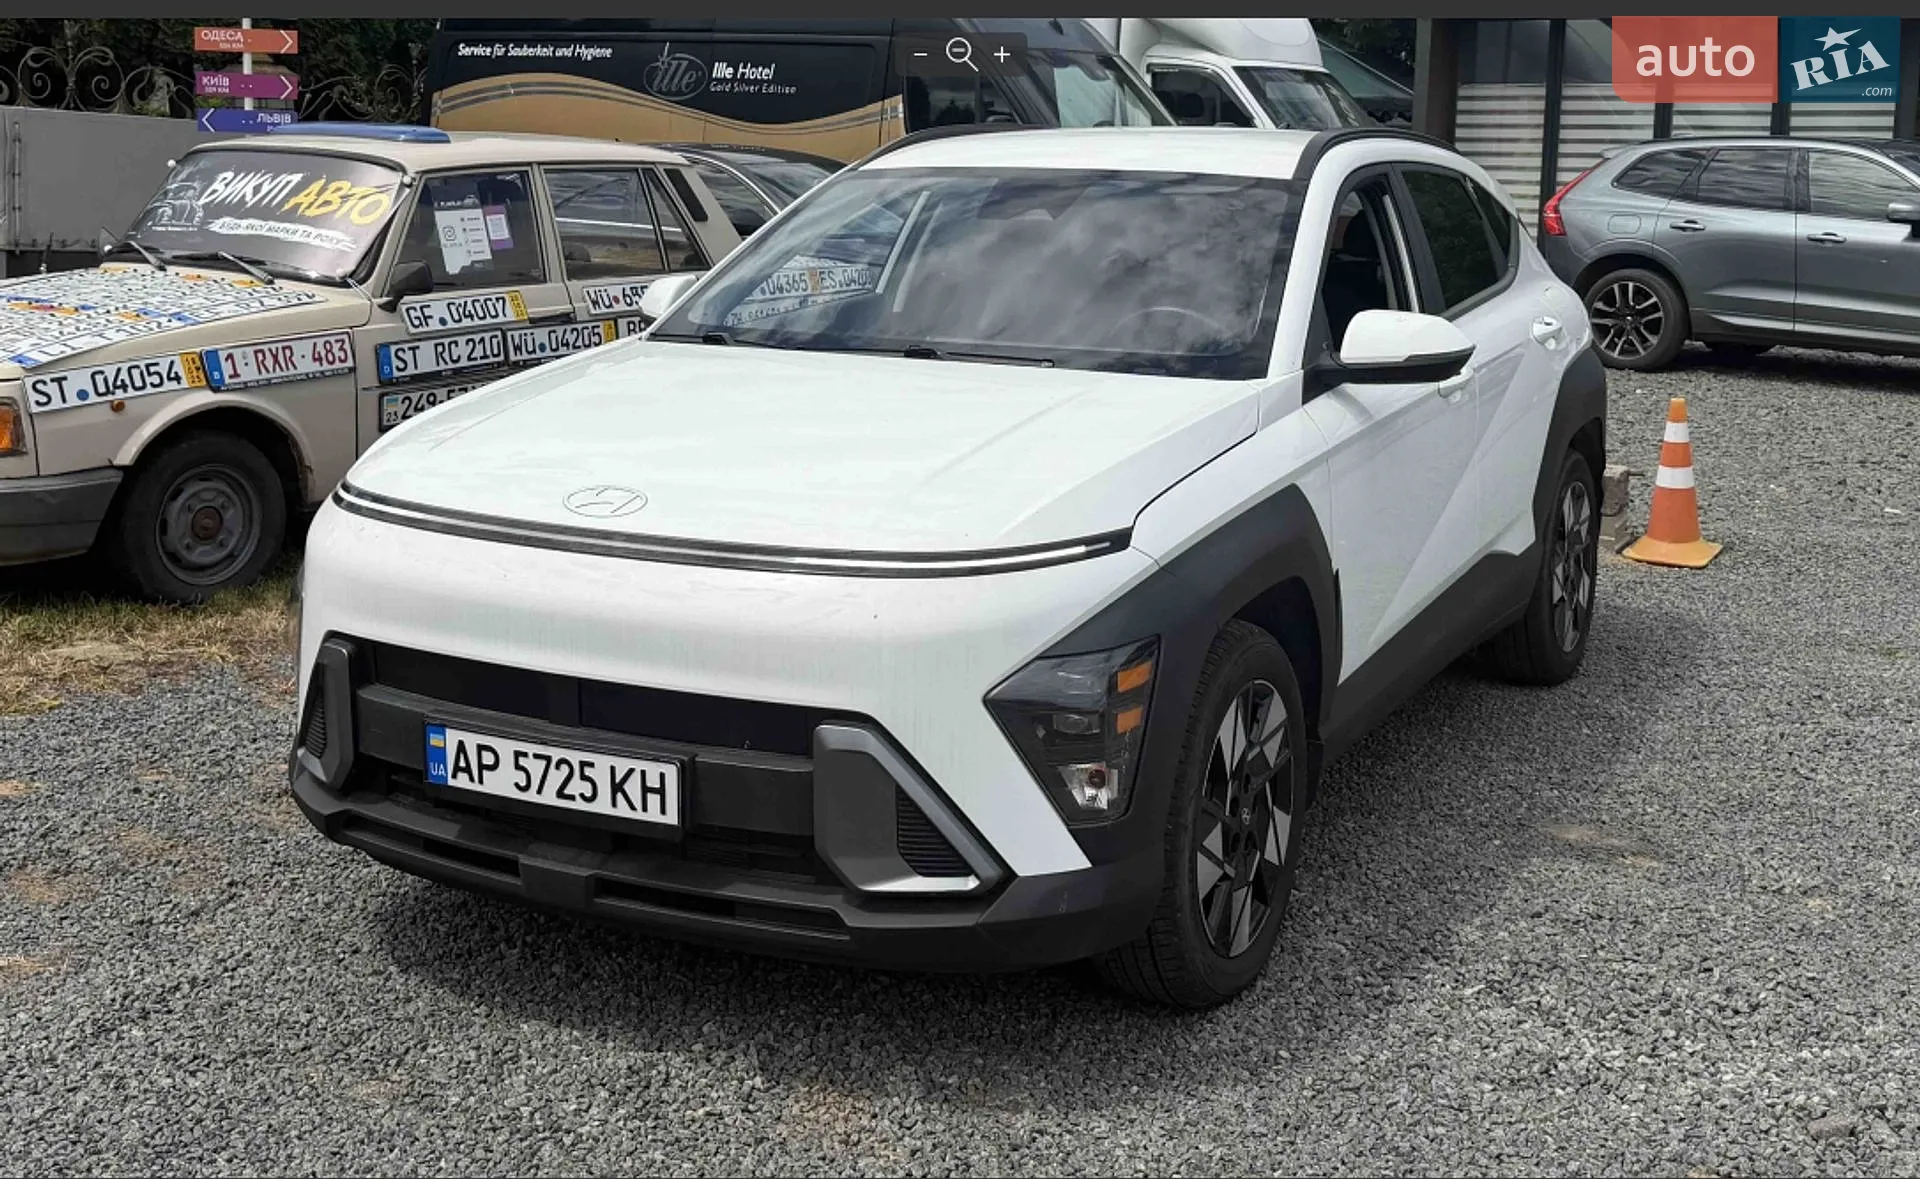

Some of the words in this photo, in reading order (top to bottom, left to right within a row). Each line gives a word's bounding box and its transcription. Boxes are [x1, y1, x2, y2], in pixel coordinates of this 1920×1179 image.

[201, 30, 244, 43] ОДЕСА
[458, 43, 491, 56] Service
[492, 44, 506, 58] für
[508, 43, 554, 57] Sauberkeit
[555, 44, 574, 57] und
[575, 44, 613, 61] Hygiene
[202, 75, 230, 86] КИЇВ
[712, 61, 734, 79] Ille
[737, 61, 776, 79] Hotel
[709, 81, 731, 92] Gold
[733, 82, 759, 94] Silver
[762, 83, 797, 94] Edition
[257, 112, 292, 124] ЛЬВІВ
[200, 170, 304, 209] ВИКУП
[278, 175, 391, 226] АВТО
[586, 288, 613, 311] WÜ
[405, 304, 434, 329] GF
[446, 296, 507, 323] 04007
[510, 332, 537, 357] WÜ
[547, 325, 603, 353] 04205
[224, 351, 241, 380] 1
[253, 345, 298, 376] RXR
[311, 338, 349, 367] 483
[394, 345, 420, 373] ST
[433, 340, 462, 367] RC
[465, 334, 502, 362] 210
[31, 375, 68, 407] ST
[90, 359, 182, 398] 04054
[430, 762, 447, 777] UA
[451, 739, 500, 786] AP
[512, 749, 599, 803] 5725
[610, 764, 667, 816] KH
